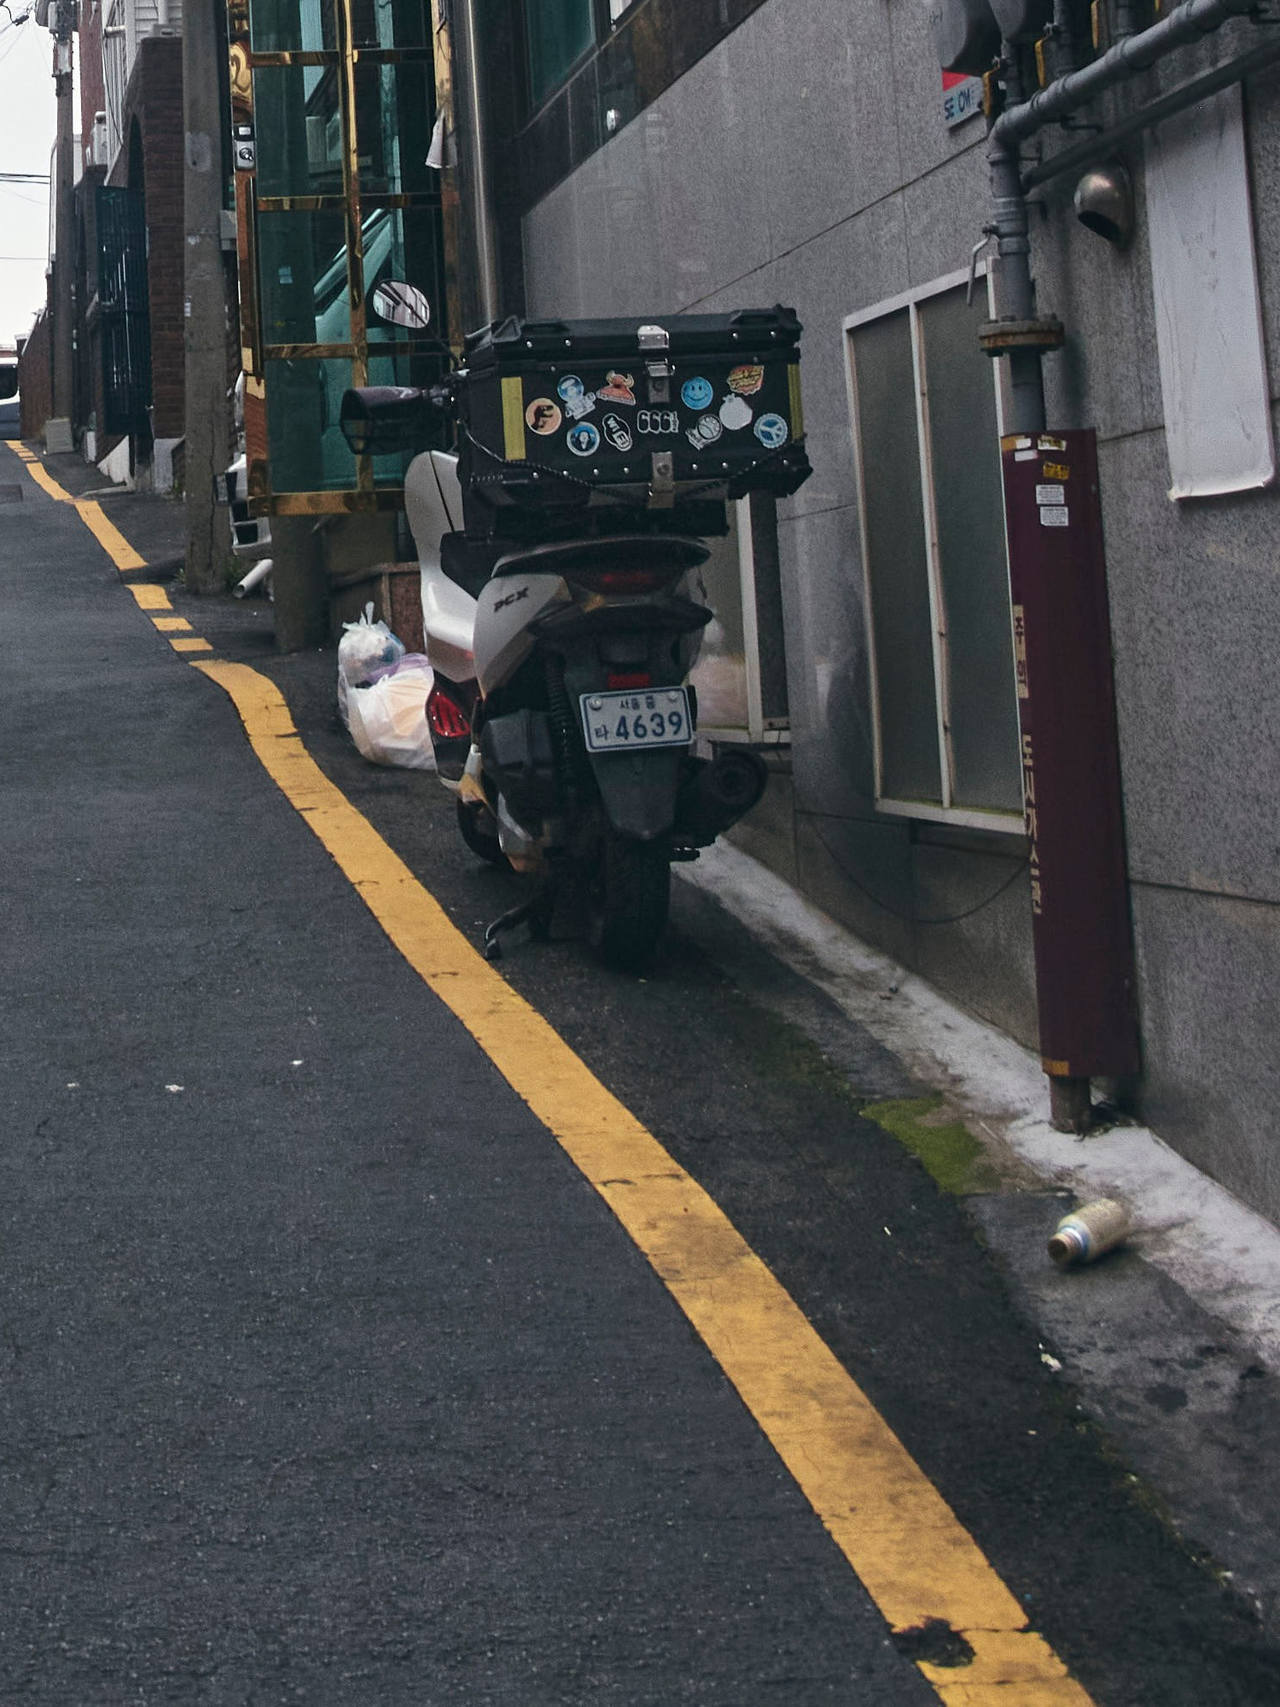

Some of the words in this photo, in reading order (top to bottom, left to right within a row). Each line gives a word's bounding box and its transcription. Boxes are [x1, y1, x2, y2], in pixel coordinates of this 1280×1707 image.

[944, 88, 971, 120] SEOM
[638, 410, 671, 433] 666
[494, 586, 529, 612] PCX
[616, 711, 683, 740] 4639
